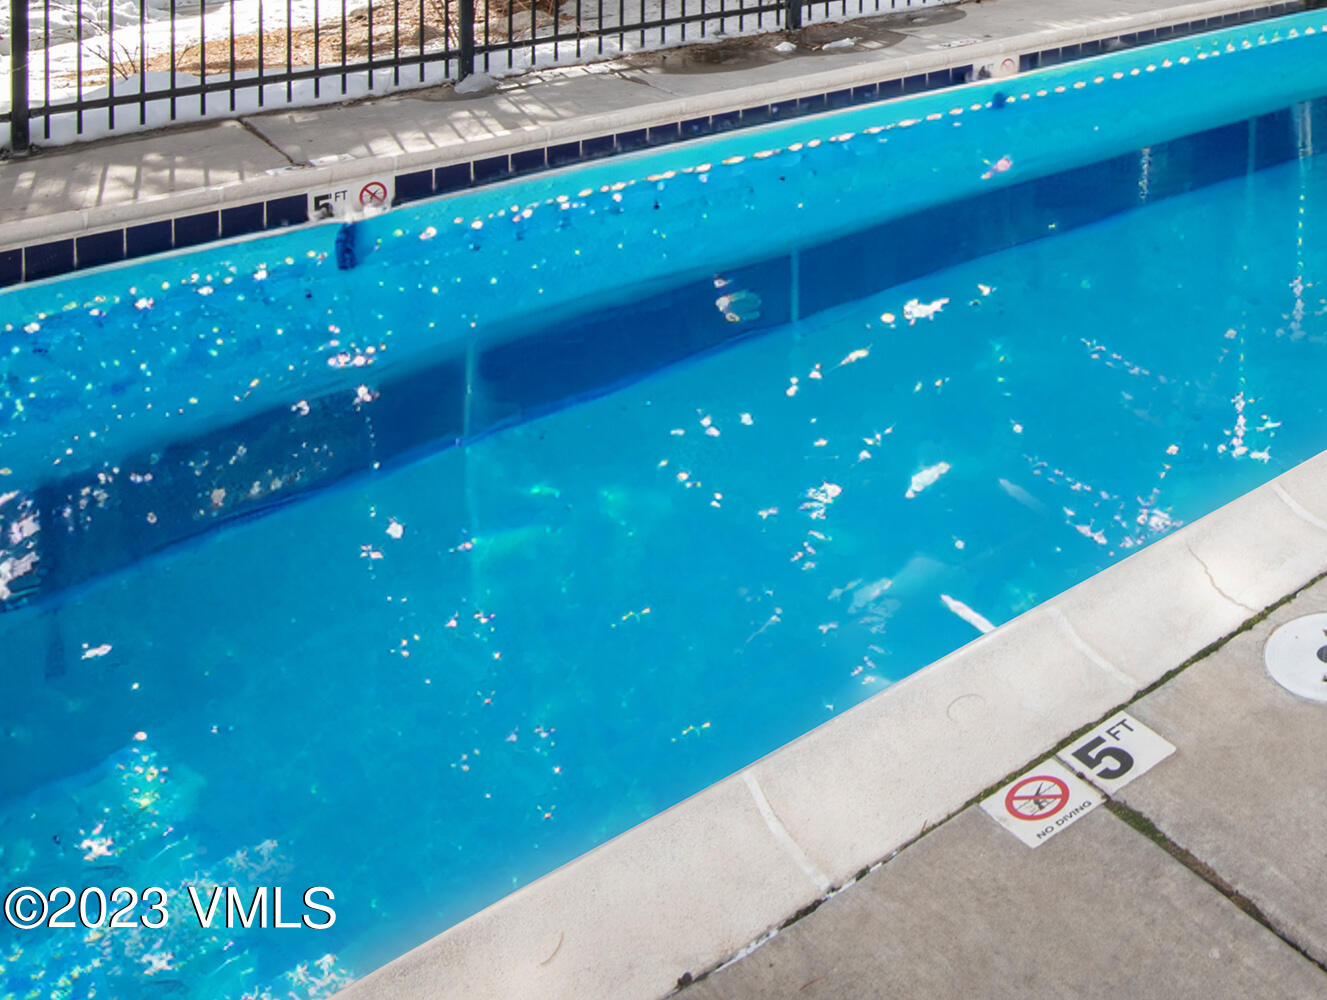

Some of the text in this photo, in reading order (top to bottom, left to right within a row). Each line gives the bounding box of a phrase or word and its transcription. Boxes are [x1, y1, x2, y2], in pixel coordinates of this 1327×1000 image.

[313, 190, 348, 219] 5 FT
[1071, 718, 1134, 780] 5 FT
[1036, 800, 1092, 840] NO DIVING
